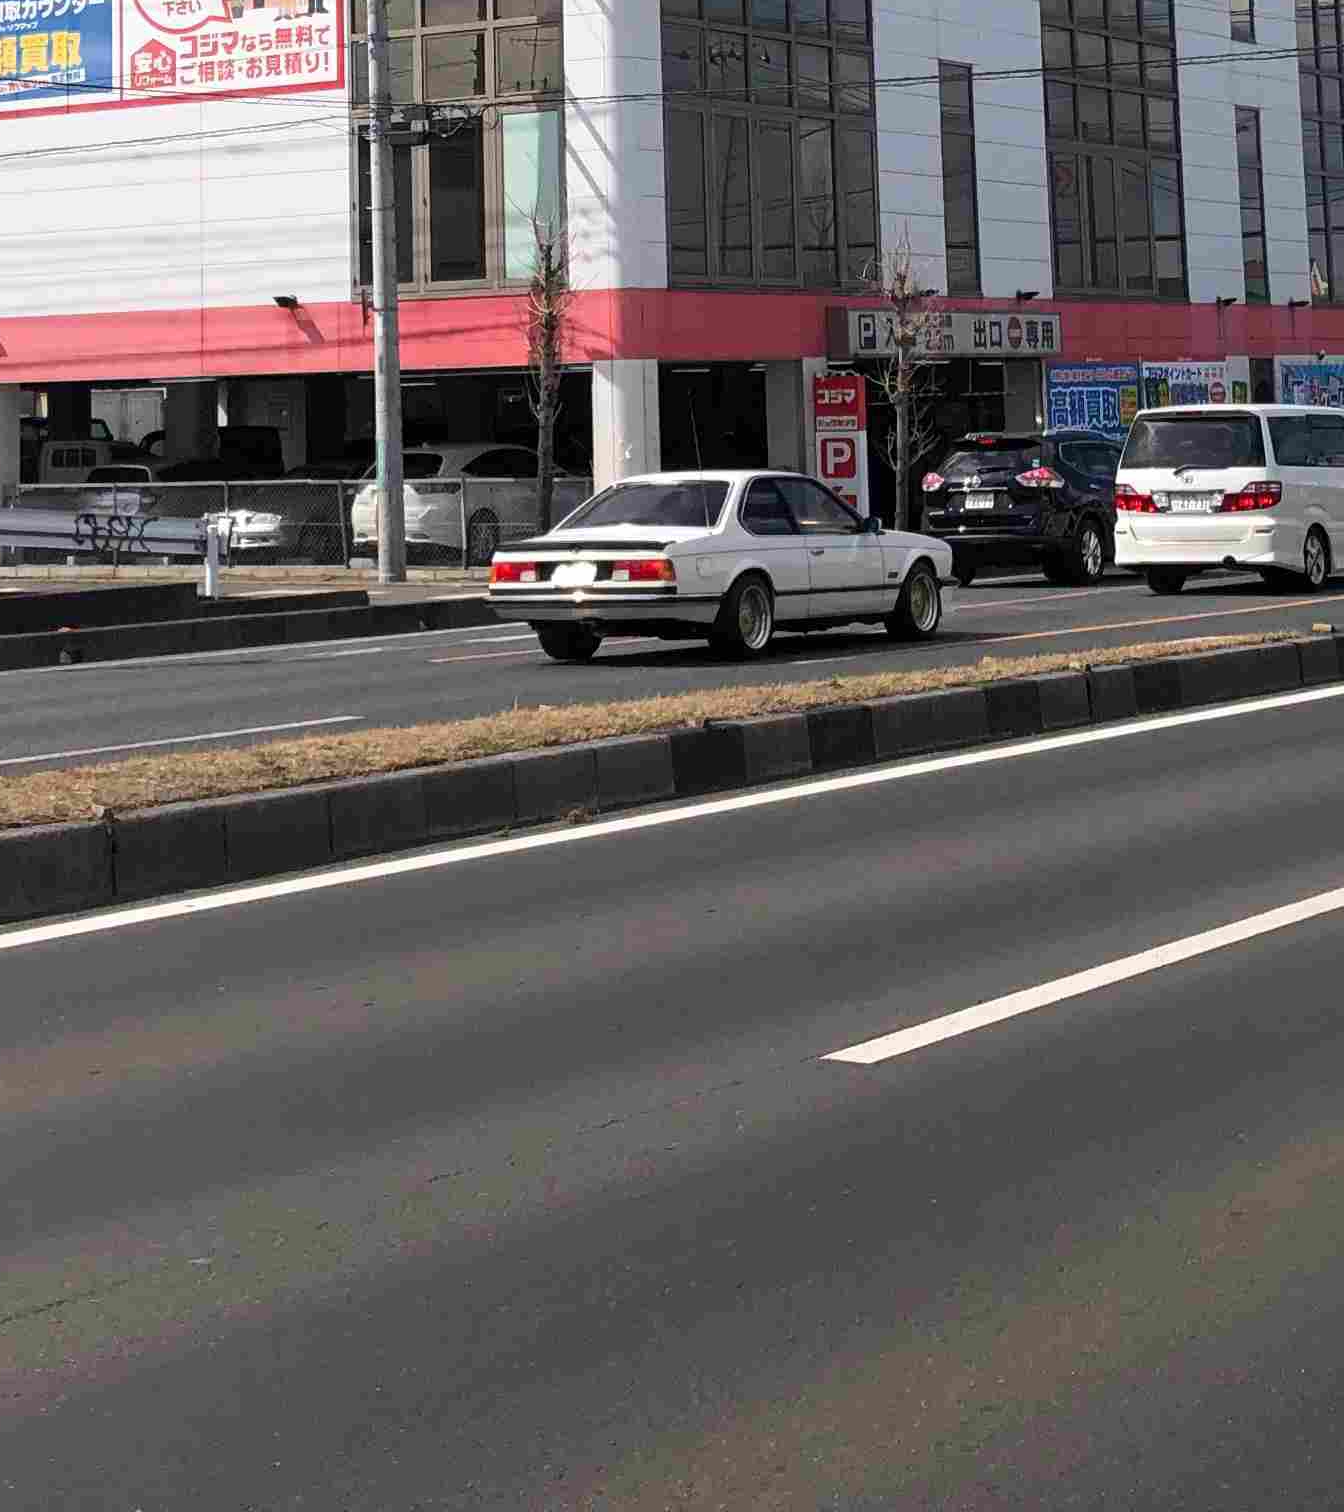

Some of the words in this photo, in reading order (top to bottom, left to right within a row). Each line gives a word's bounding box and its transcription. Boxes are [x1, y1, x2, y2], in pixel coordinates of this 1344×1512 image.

[163, 0, 202, 17] 下さい
[179, 24, 330, 59] コジマなら無料で
[973, 319, 1002, 348] 出口
[826, 441, 851, 474] P
